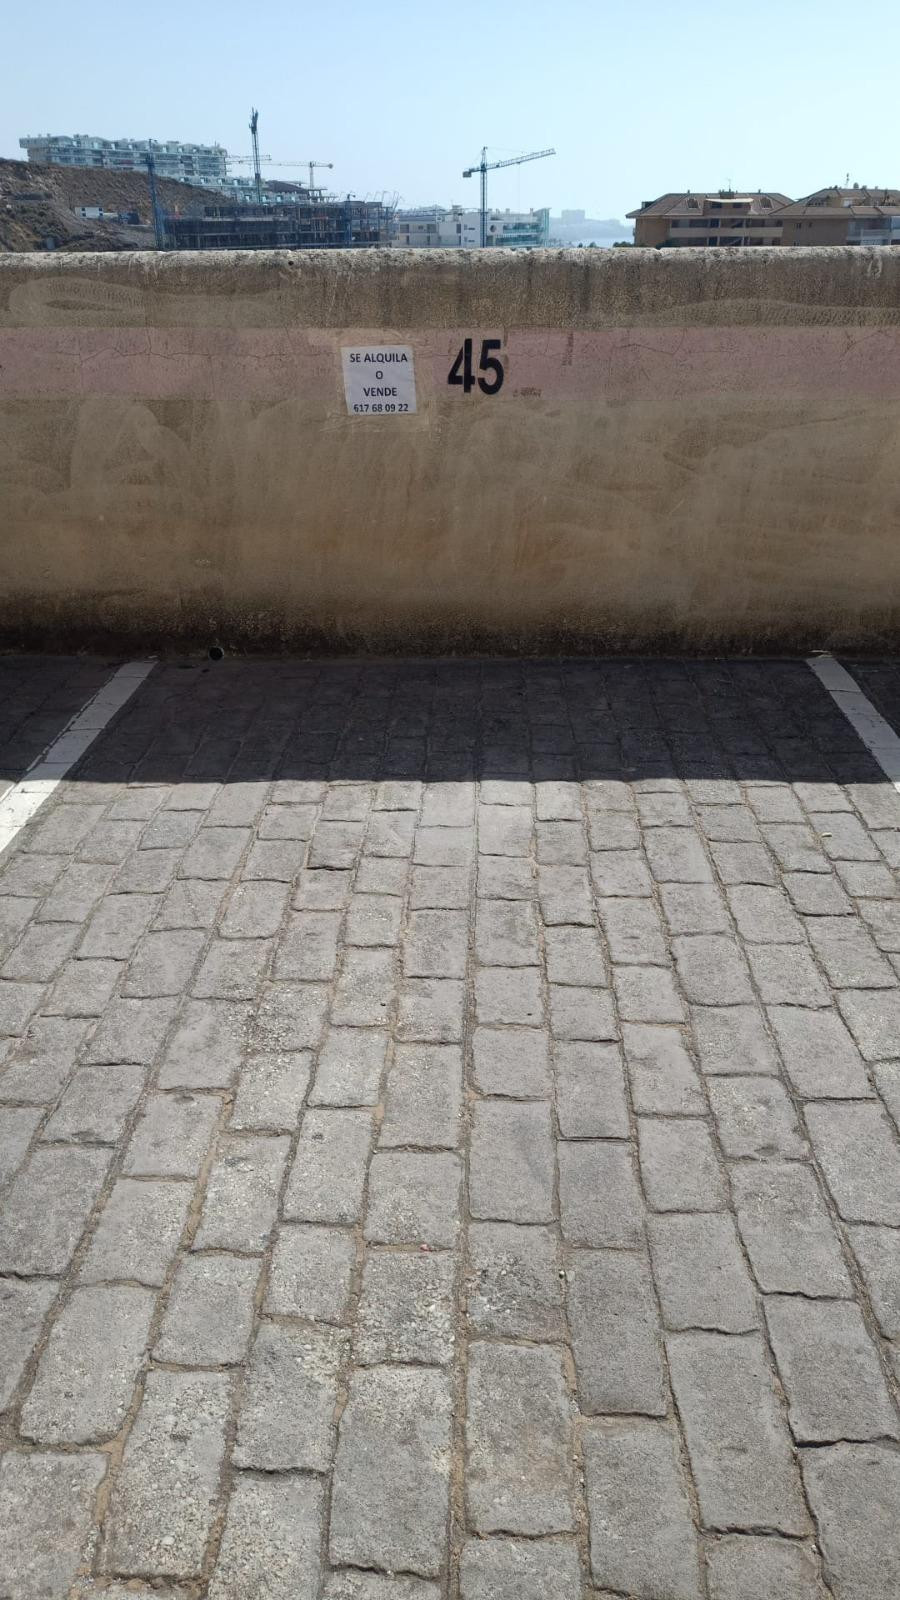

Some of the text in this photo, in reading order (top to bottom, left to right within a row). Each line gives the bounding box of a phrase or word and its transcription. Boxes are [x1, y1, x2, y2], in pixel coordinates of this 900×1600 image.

[350, 353, 408, 363] SE ALQUILA
[448, 338, 504, 395] 45
[375, 370, 384, 380] O
[363, 387, 398, 397] VENDE
[353, 404, 409, 412] 617 68 09 22
